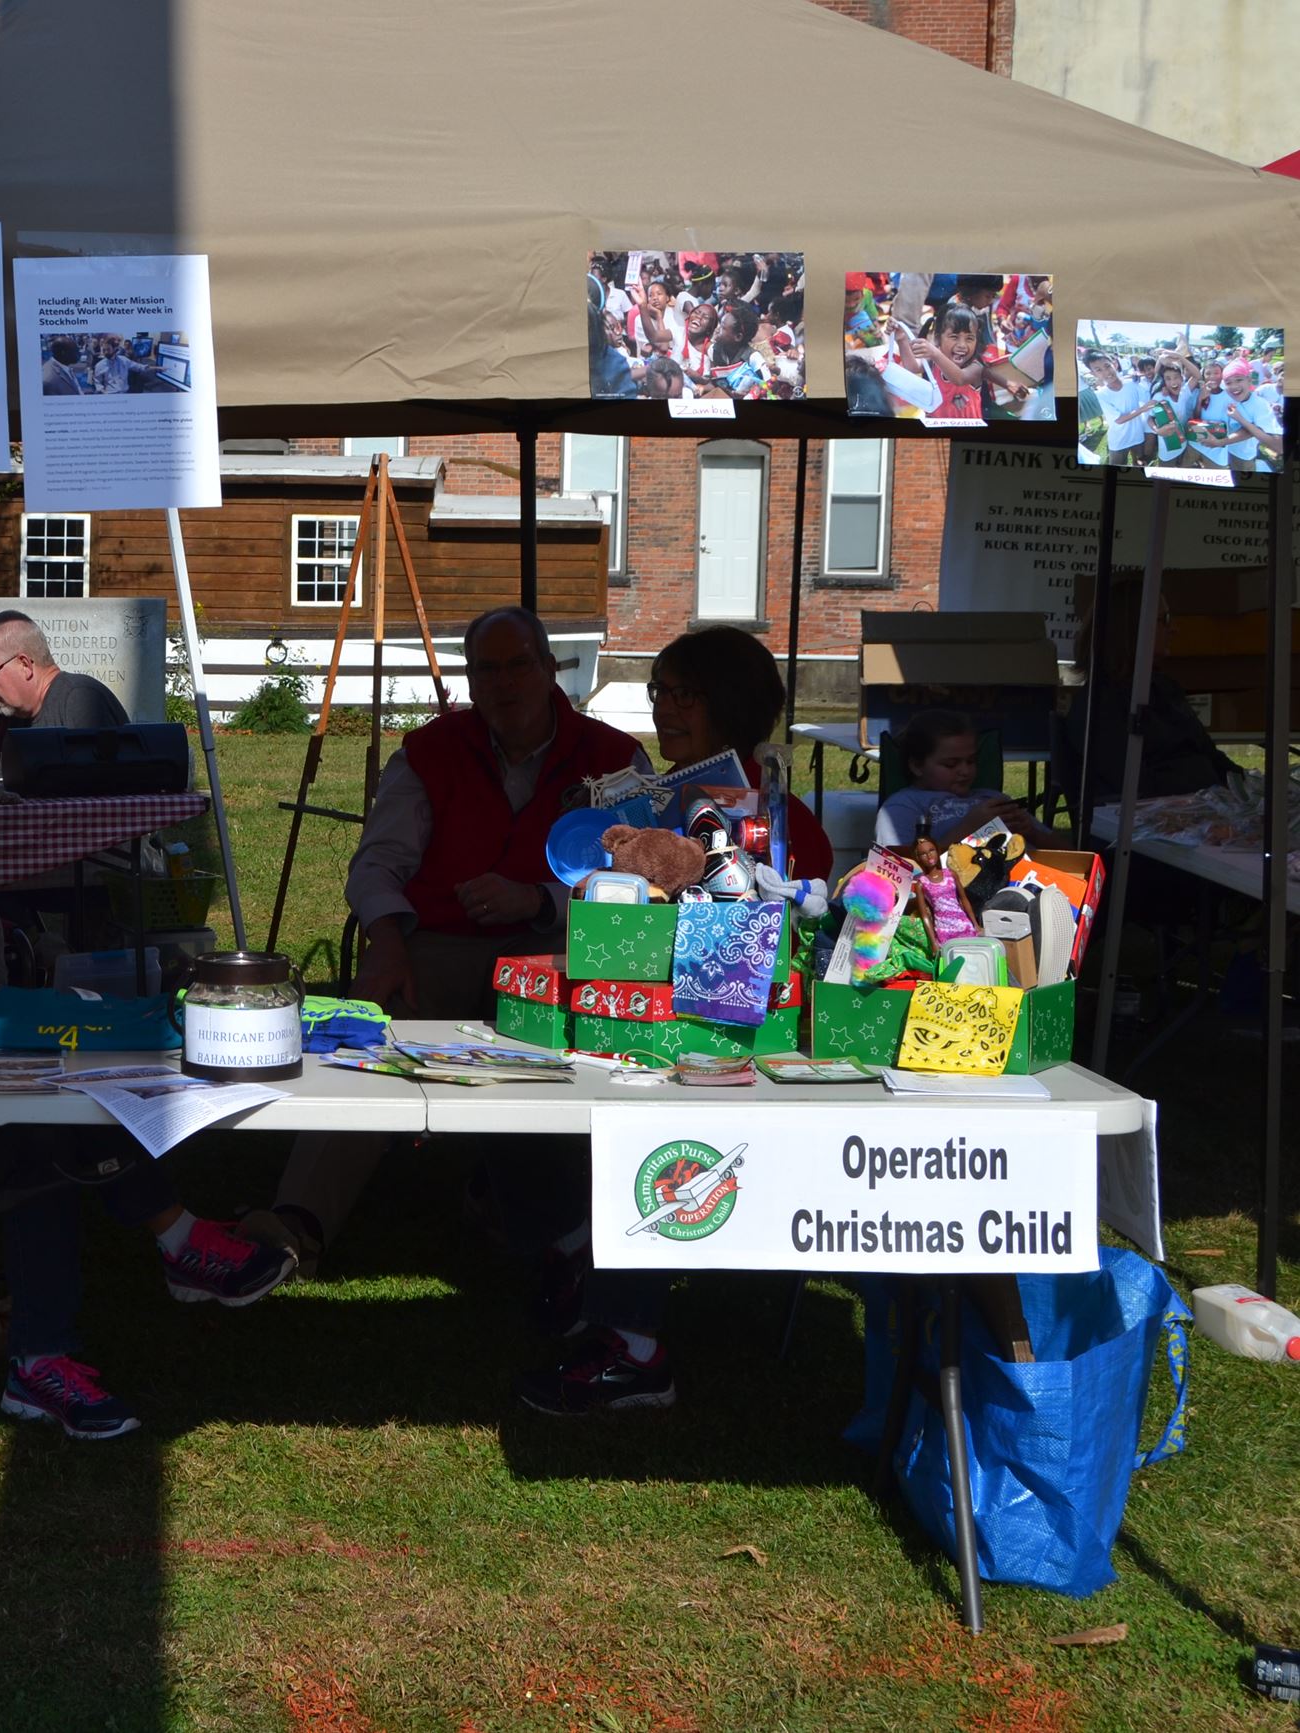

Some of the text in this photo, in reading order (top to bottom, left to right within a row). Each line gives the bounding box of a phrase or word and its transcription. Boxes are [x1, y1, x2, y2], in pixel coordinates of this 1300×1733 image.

[38, 296, 165, 308] Including All: Water Mission
[39, 306, 173, 316] Attends World Water Week in
[39, 316, 88, 326] Stockholm
[675, 404, 730, 416] Zambia
[962, 448, 1043, 470] THANK
[1023, 490, 1083, 502] WESTAFF
[1176, 499, 1218, 510] LAURA
[988, 506, 1008, 516] ST.
[1014, 506, 1058, 518] MARYS
[975, 522, 992, 532] RJ
[996, 523, 1042, 535] BURKE
[984, 540, 1020, 551] KUCK
[1204, 534, 1240, 546] CISCO
[1034, 560, 1096, 572] PLUS ONE
[41, 620, 90, 632] NITION
[883, 860, 898, 872] PEN
[876, 866, 902, 884] STYLO
[198, 1029, 265, 1043] HURRICANE
[197, 1051, 290, 1066] BAHAMAS RELIEF
[842, 1134, 1008, 1190] Operation
[642, 1143, 716, 1214] Samaritan's Purse
[679, 1183, 730, 1223] OPERATION
[668, 1201, 730, 1238] Christmas Child
[791, 1208, 1073, 1256] Christmas Child
